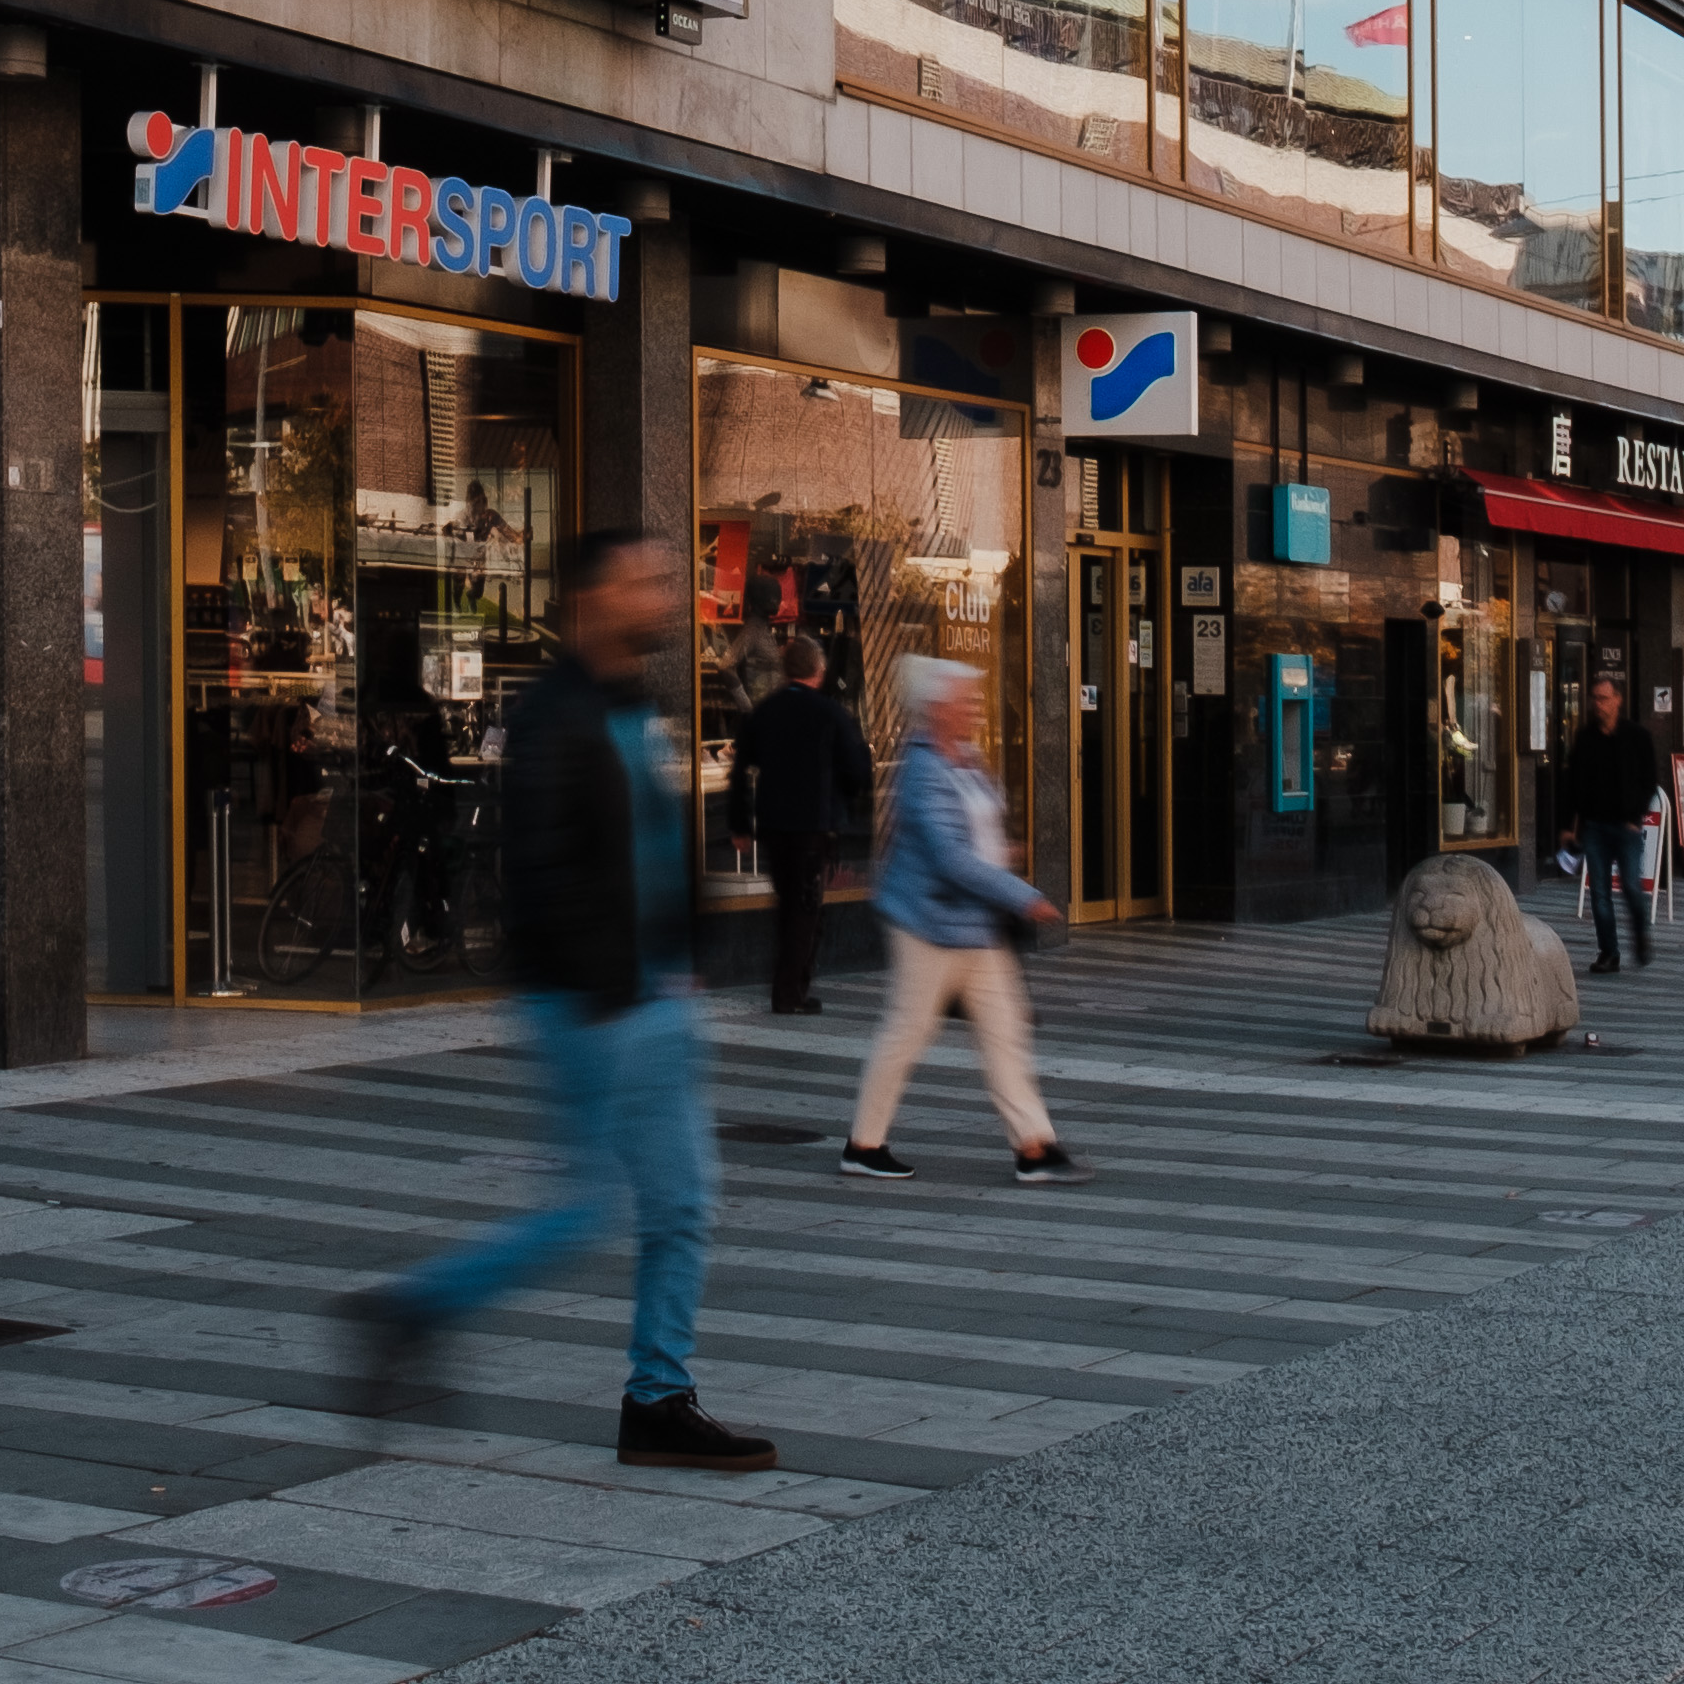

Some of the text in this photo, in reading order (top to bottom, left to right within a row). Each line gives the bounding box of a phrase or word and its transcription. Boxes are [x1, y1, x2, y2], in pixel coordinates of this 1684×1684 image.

[672, 13, 699, 32] OCEAN
[225, 126, 632, 302] INTERSPORT
[1036, 448, 1062, 488] 23
[1187, 570, 1214, 593] afa
[945, 580, 990, 624] Club
[945, 624, 991, 653] DAGAR
[1196, 620, 1221, 638] 23
